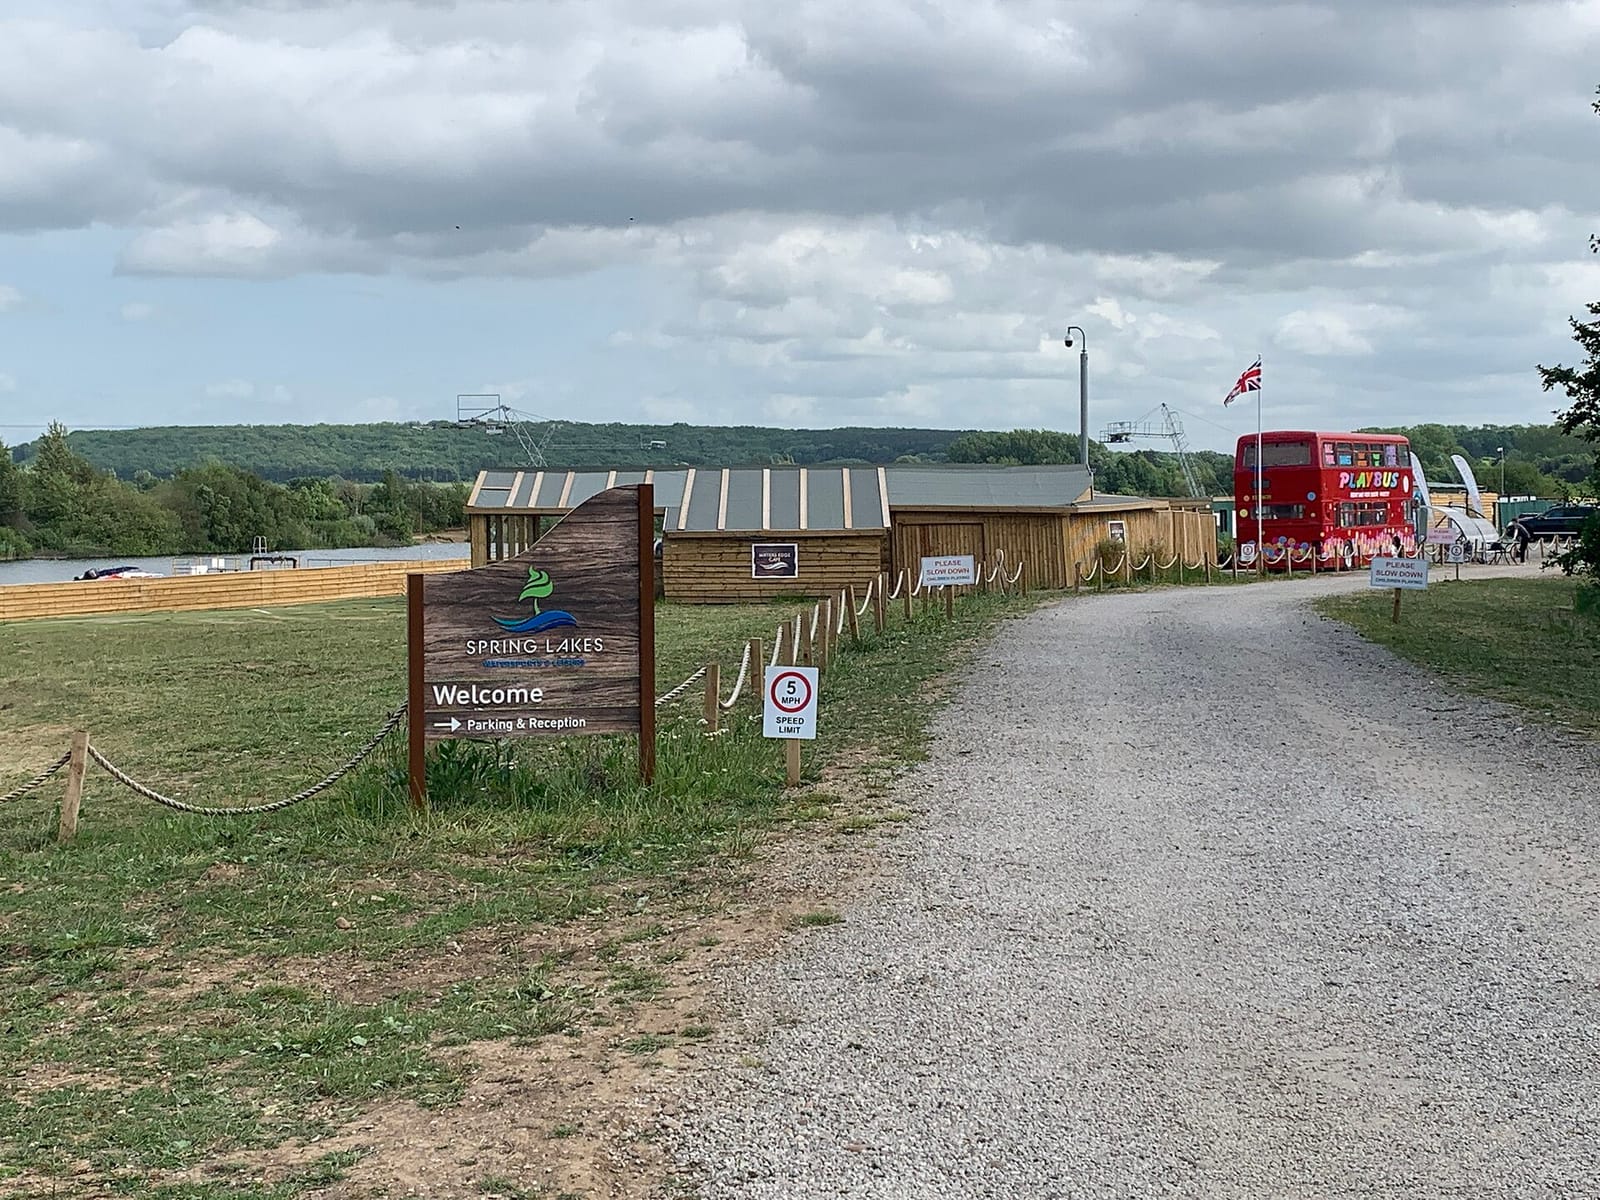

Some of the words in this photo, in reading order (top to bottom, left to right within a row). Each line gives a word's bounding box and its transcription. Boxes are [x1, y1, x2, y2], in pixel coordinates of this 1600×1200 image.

[1339, 472, 1399, 488] PLAYBUS
[466, 639, 537, 655] SPRING
[546, 637, 604, 653] LAKES
[432, 684, 543, 705] Welcome
[786, 681, 796, 695] 5
[467, 718, 513, 731] Parking
[516, 718, 526, 729] &
[529, 717, 586, 731] Reception
[776, 716, 805, 725] SPEED
[778, 726, 801, 734] LIMIT
